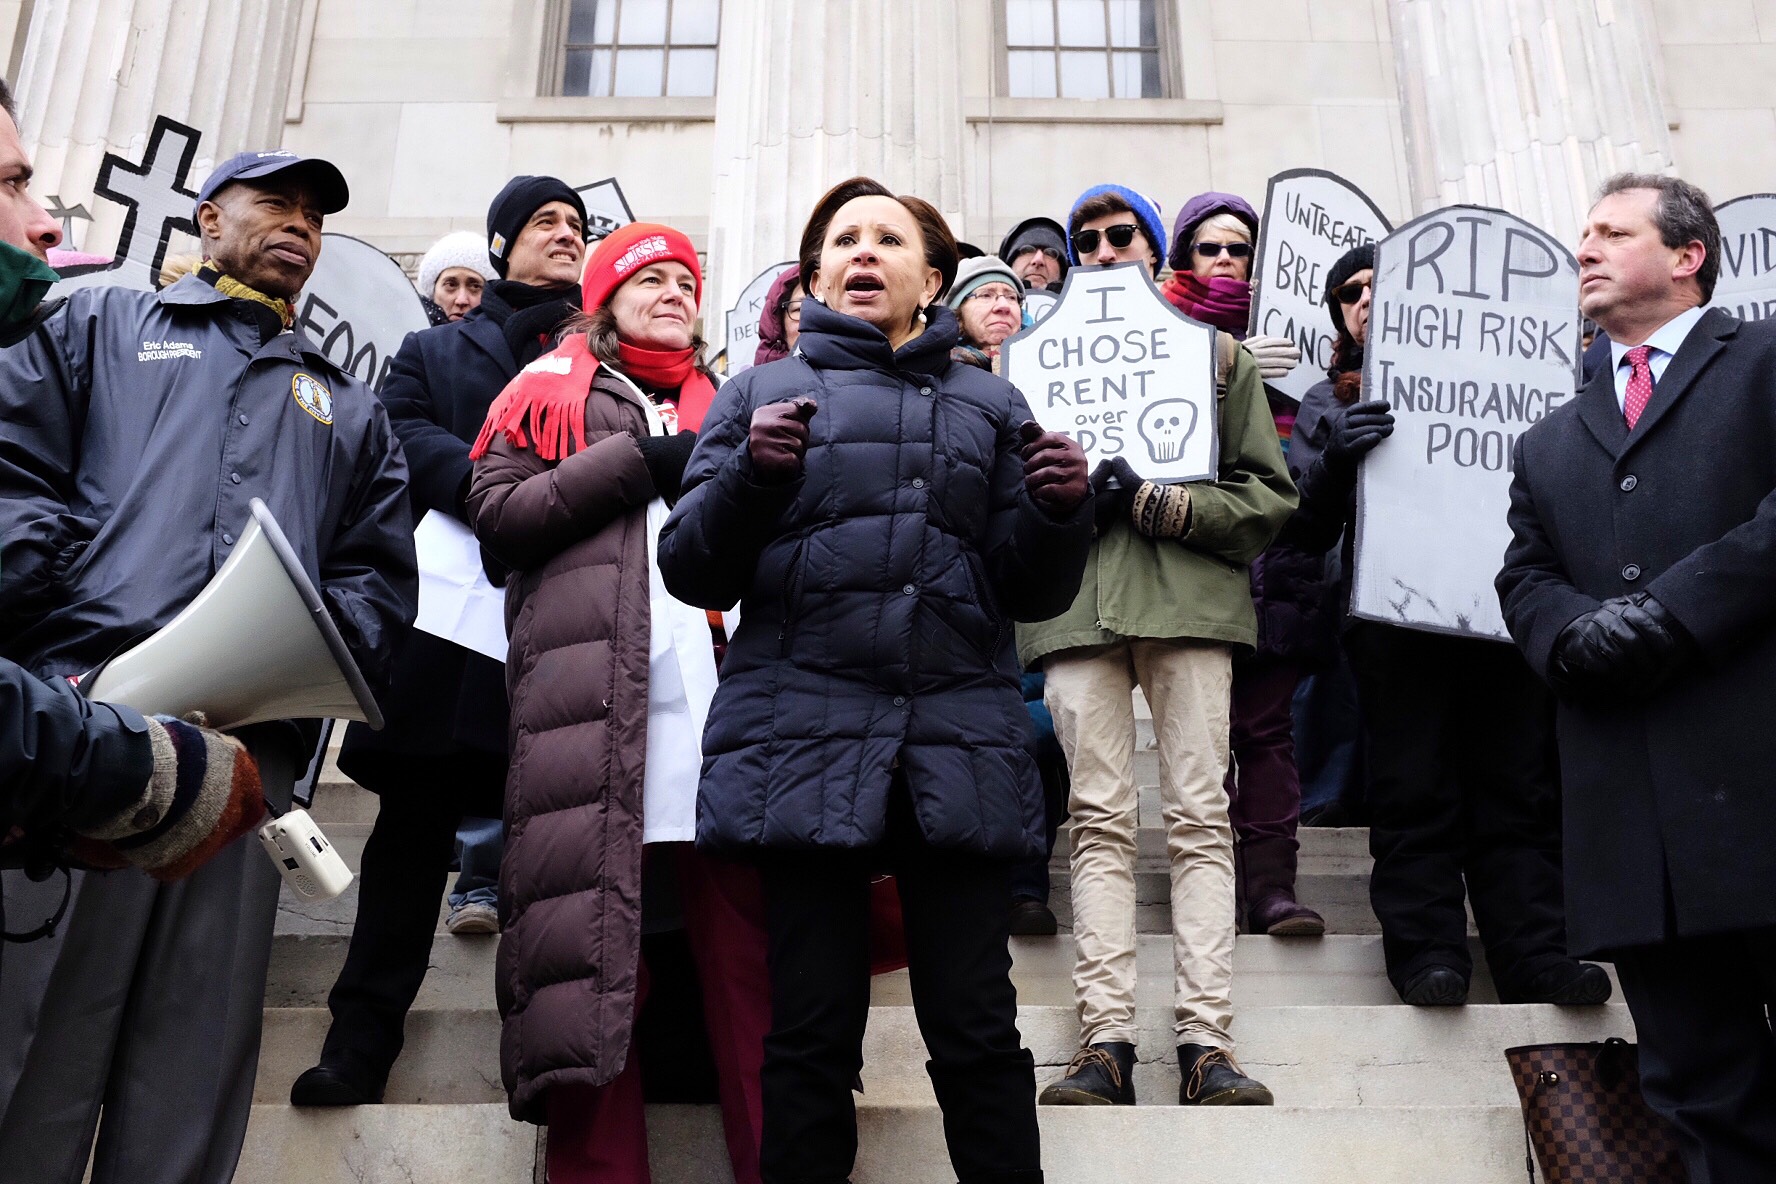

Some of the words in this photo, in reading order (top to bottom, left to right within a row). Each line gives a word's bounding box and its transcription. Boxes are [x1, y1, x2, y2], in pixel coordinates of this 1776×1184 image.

[613, 238, 668, 274] NURSES
[1406, 216, 1559, 302] RIP
[1085, 286, 1126, 325] I
[143, 341, 161, 350] Eric
[163, 341, 194, 349] Adams
[1038, 328, 1171, 370] CHOSE
[1382, 301, 1463, 351] HIGH
[1480, 311, 1572, 364] RISK
[137, 350, 169, 361] BOROUGH
[169, 348, 202, 359] PRESIDENT
[1047, 370, 1156, 408] RENT
[1379, 360, 1566, 424] INSURANCE
[1075, 410, 1129, 426] over
